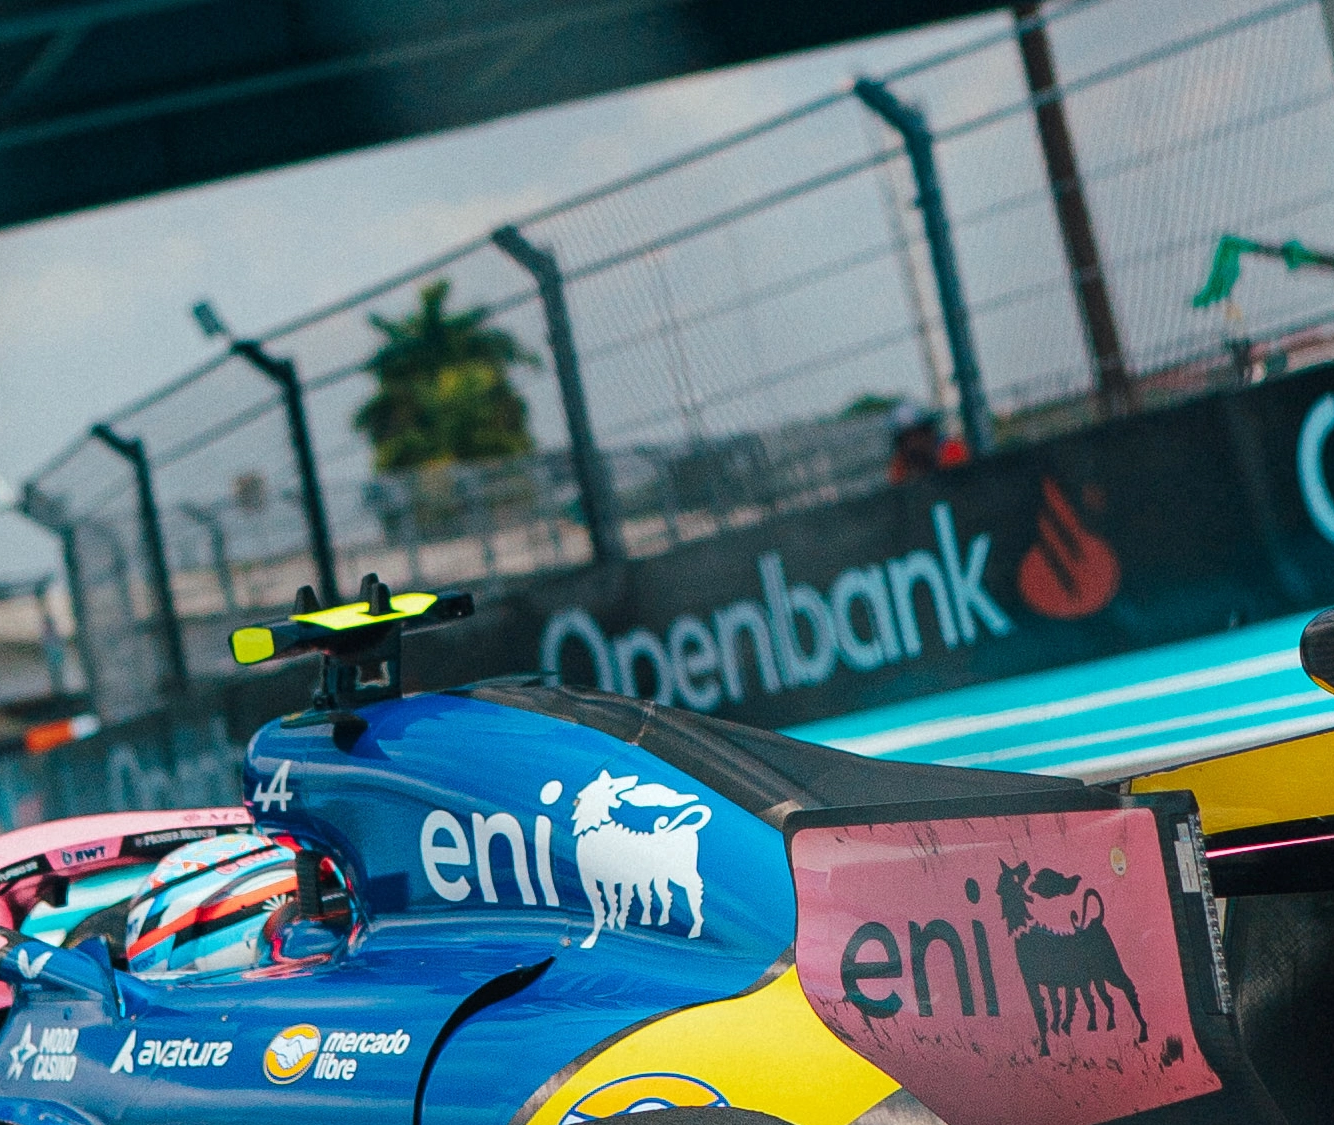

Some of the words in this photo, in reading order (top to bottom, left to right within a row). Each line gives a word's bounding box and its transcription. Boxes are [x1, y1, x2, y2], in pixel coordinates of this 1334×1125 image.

[420, 780, 563, 907] eni
[840, 876, 1000, 1018] eni
[39, 1028, 79, 1054] MODO
[137, 1038, 233, 1067] avature
[322, 1029, 411, 1055] mercado
[32, 1055, 77, 1081] CASINO
[313, 1053, 357, 1081] libre
